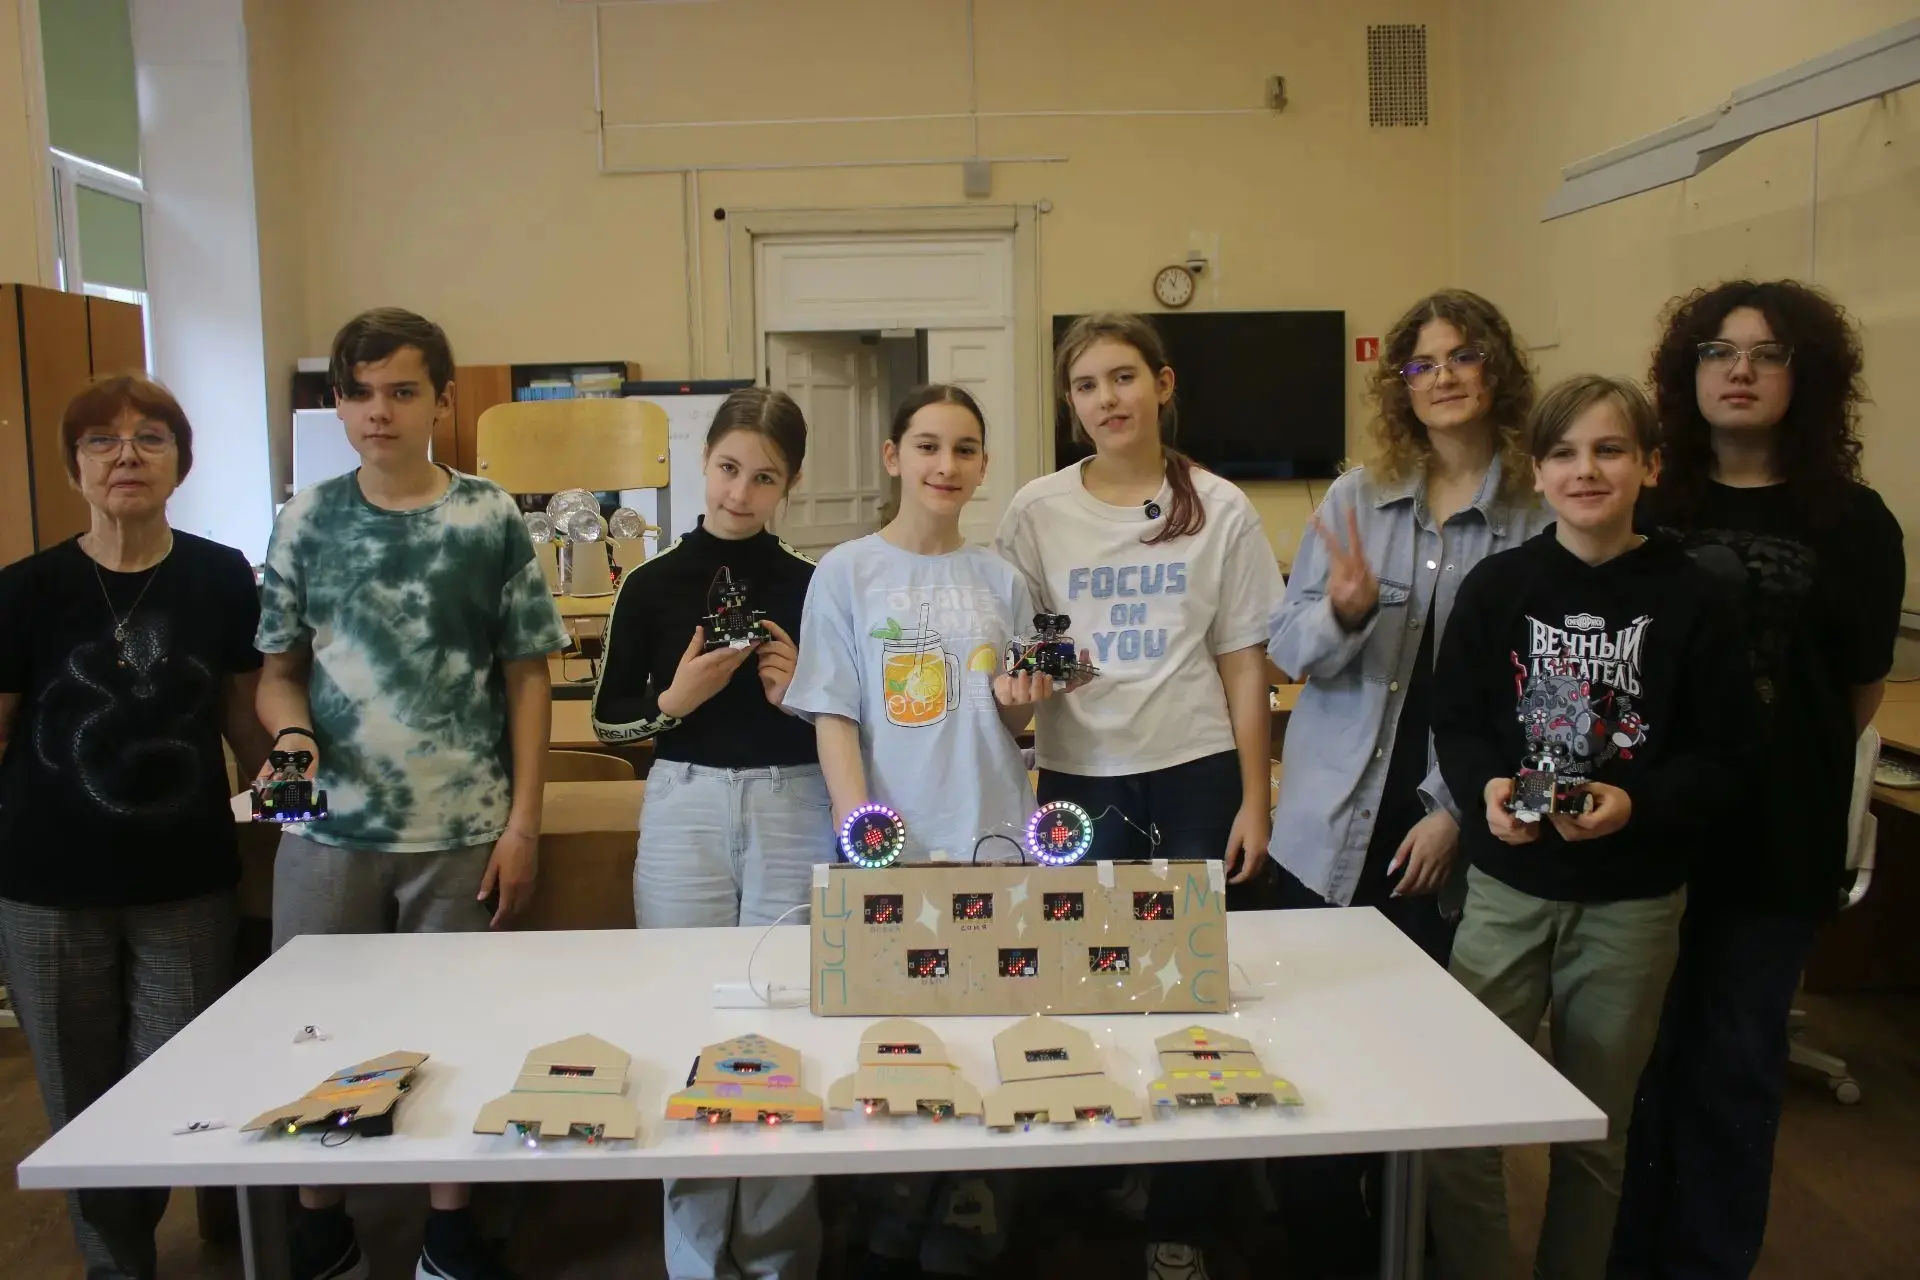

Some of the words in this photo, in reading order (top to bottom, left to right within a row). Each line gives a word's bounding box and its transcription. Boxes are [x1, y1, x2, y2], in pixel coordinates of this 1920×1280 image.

[1069, 562, 1187, 600] FOCUS
[1111, 603, 1147, 626] ON
[1093, 628, 1167, 662] YOU
[1525, 615, 1653, 675] ВЕЧНЫЙ
